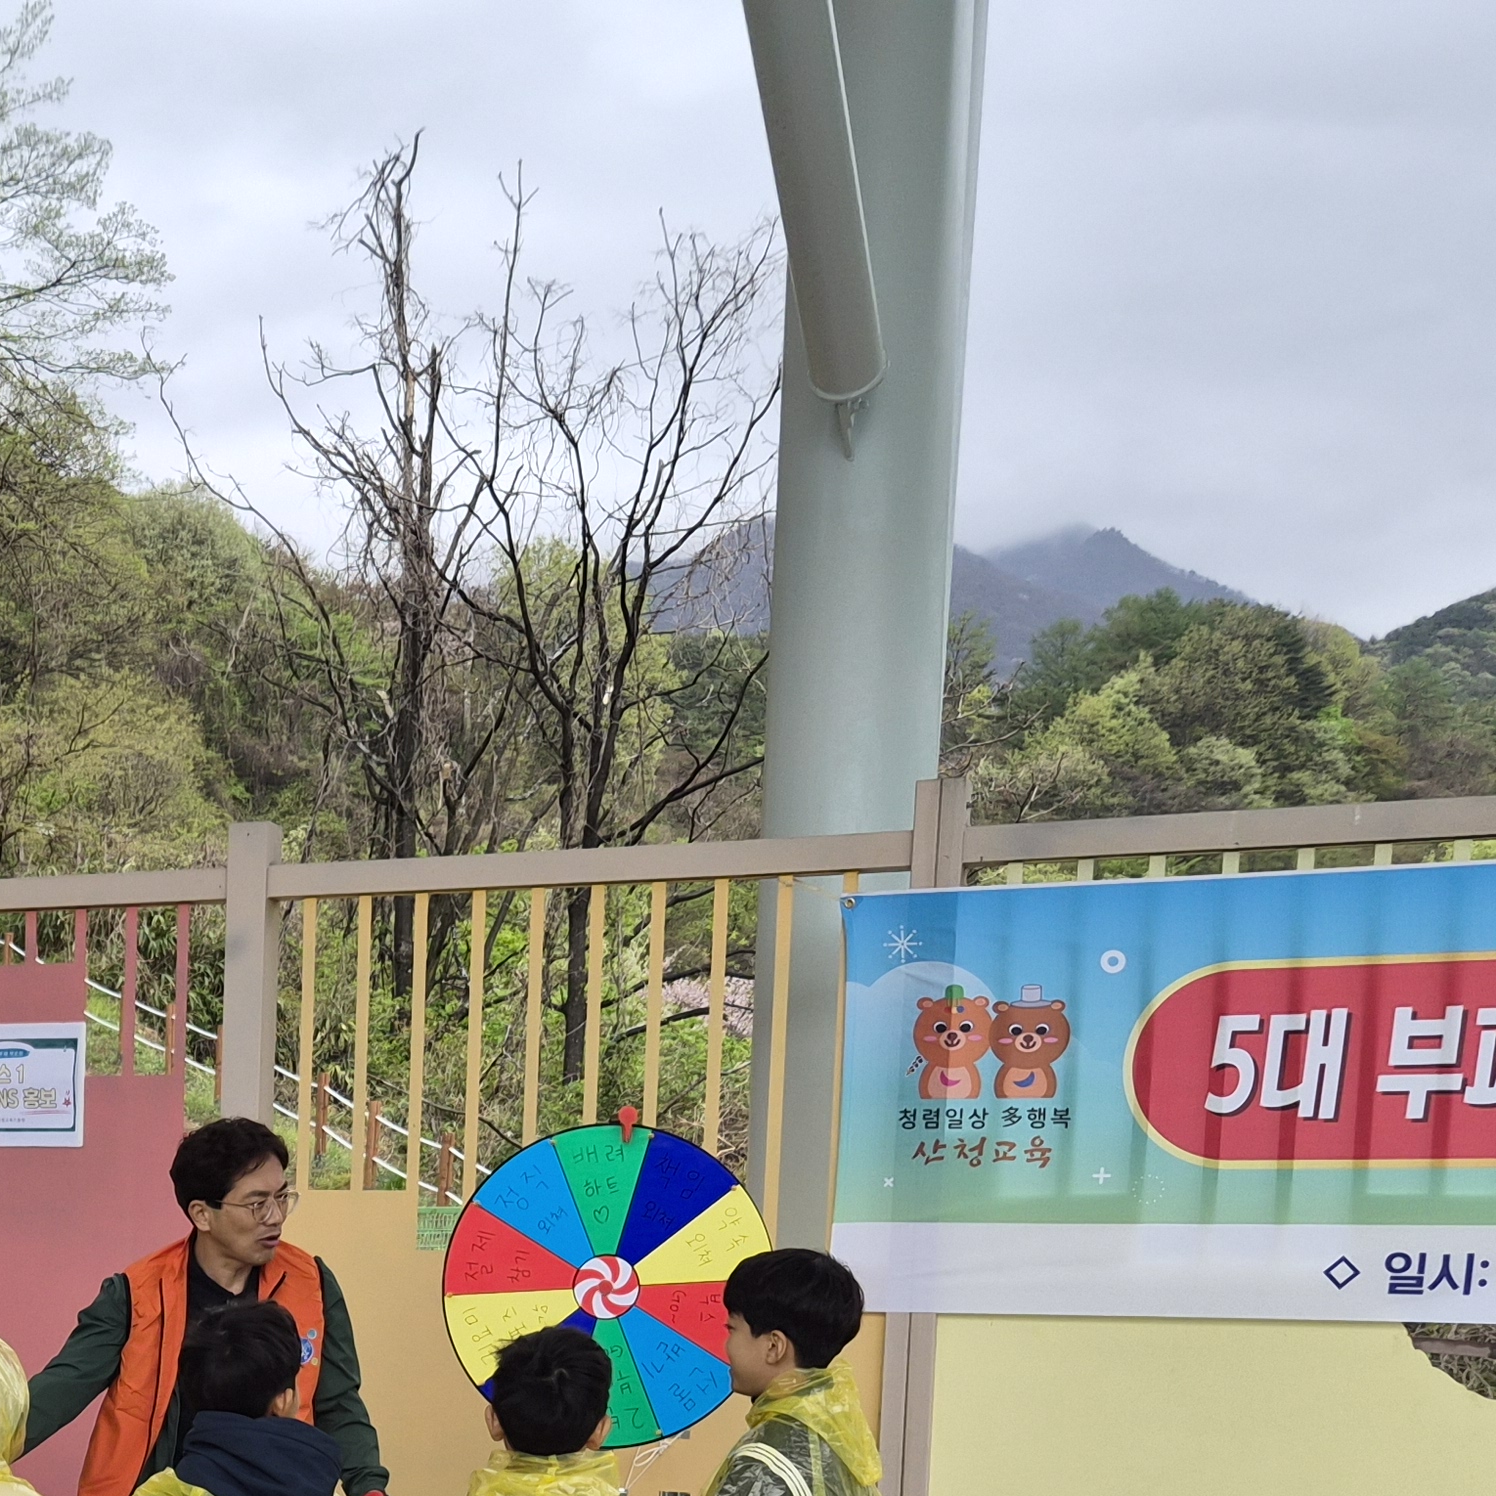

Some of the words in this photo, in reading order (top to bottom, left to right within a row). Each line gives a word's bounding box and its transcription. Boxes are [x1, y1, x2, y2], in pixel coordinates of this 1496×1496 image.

[16, 1064, 24, 1084] 1
[1204, 1007, 1350, 1120] 5대
[1375, 1005, 1496, 1120] 부
[23, 1087, 57, 1109] 홍보
[898, 1106, 990, 1130] 청렴일상
[1001, 1106, 1072, 1130] 多행복
[572, 1144, 625, 1164] 배려
[911, 1135, 1053, 1169] 산청교육
[494, 1164, 550, 1211] 정직
[583, 1176, 620, 1198] 하트
[654, 1152, 706, 1200] 책임
[718, 1207, 749, 1252] 약속
[464, 1230, 497, 1282] 절제
[1384, 1252, 1490, 1296] 일시:
[699, 1293, 721, 1322] 부스
[641, 1341, 685, 1379] 받기
[668, 1367, 718, 1412] 선물
